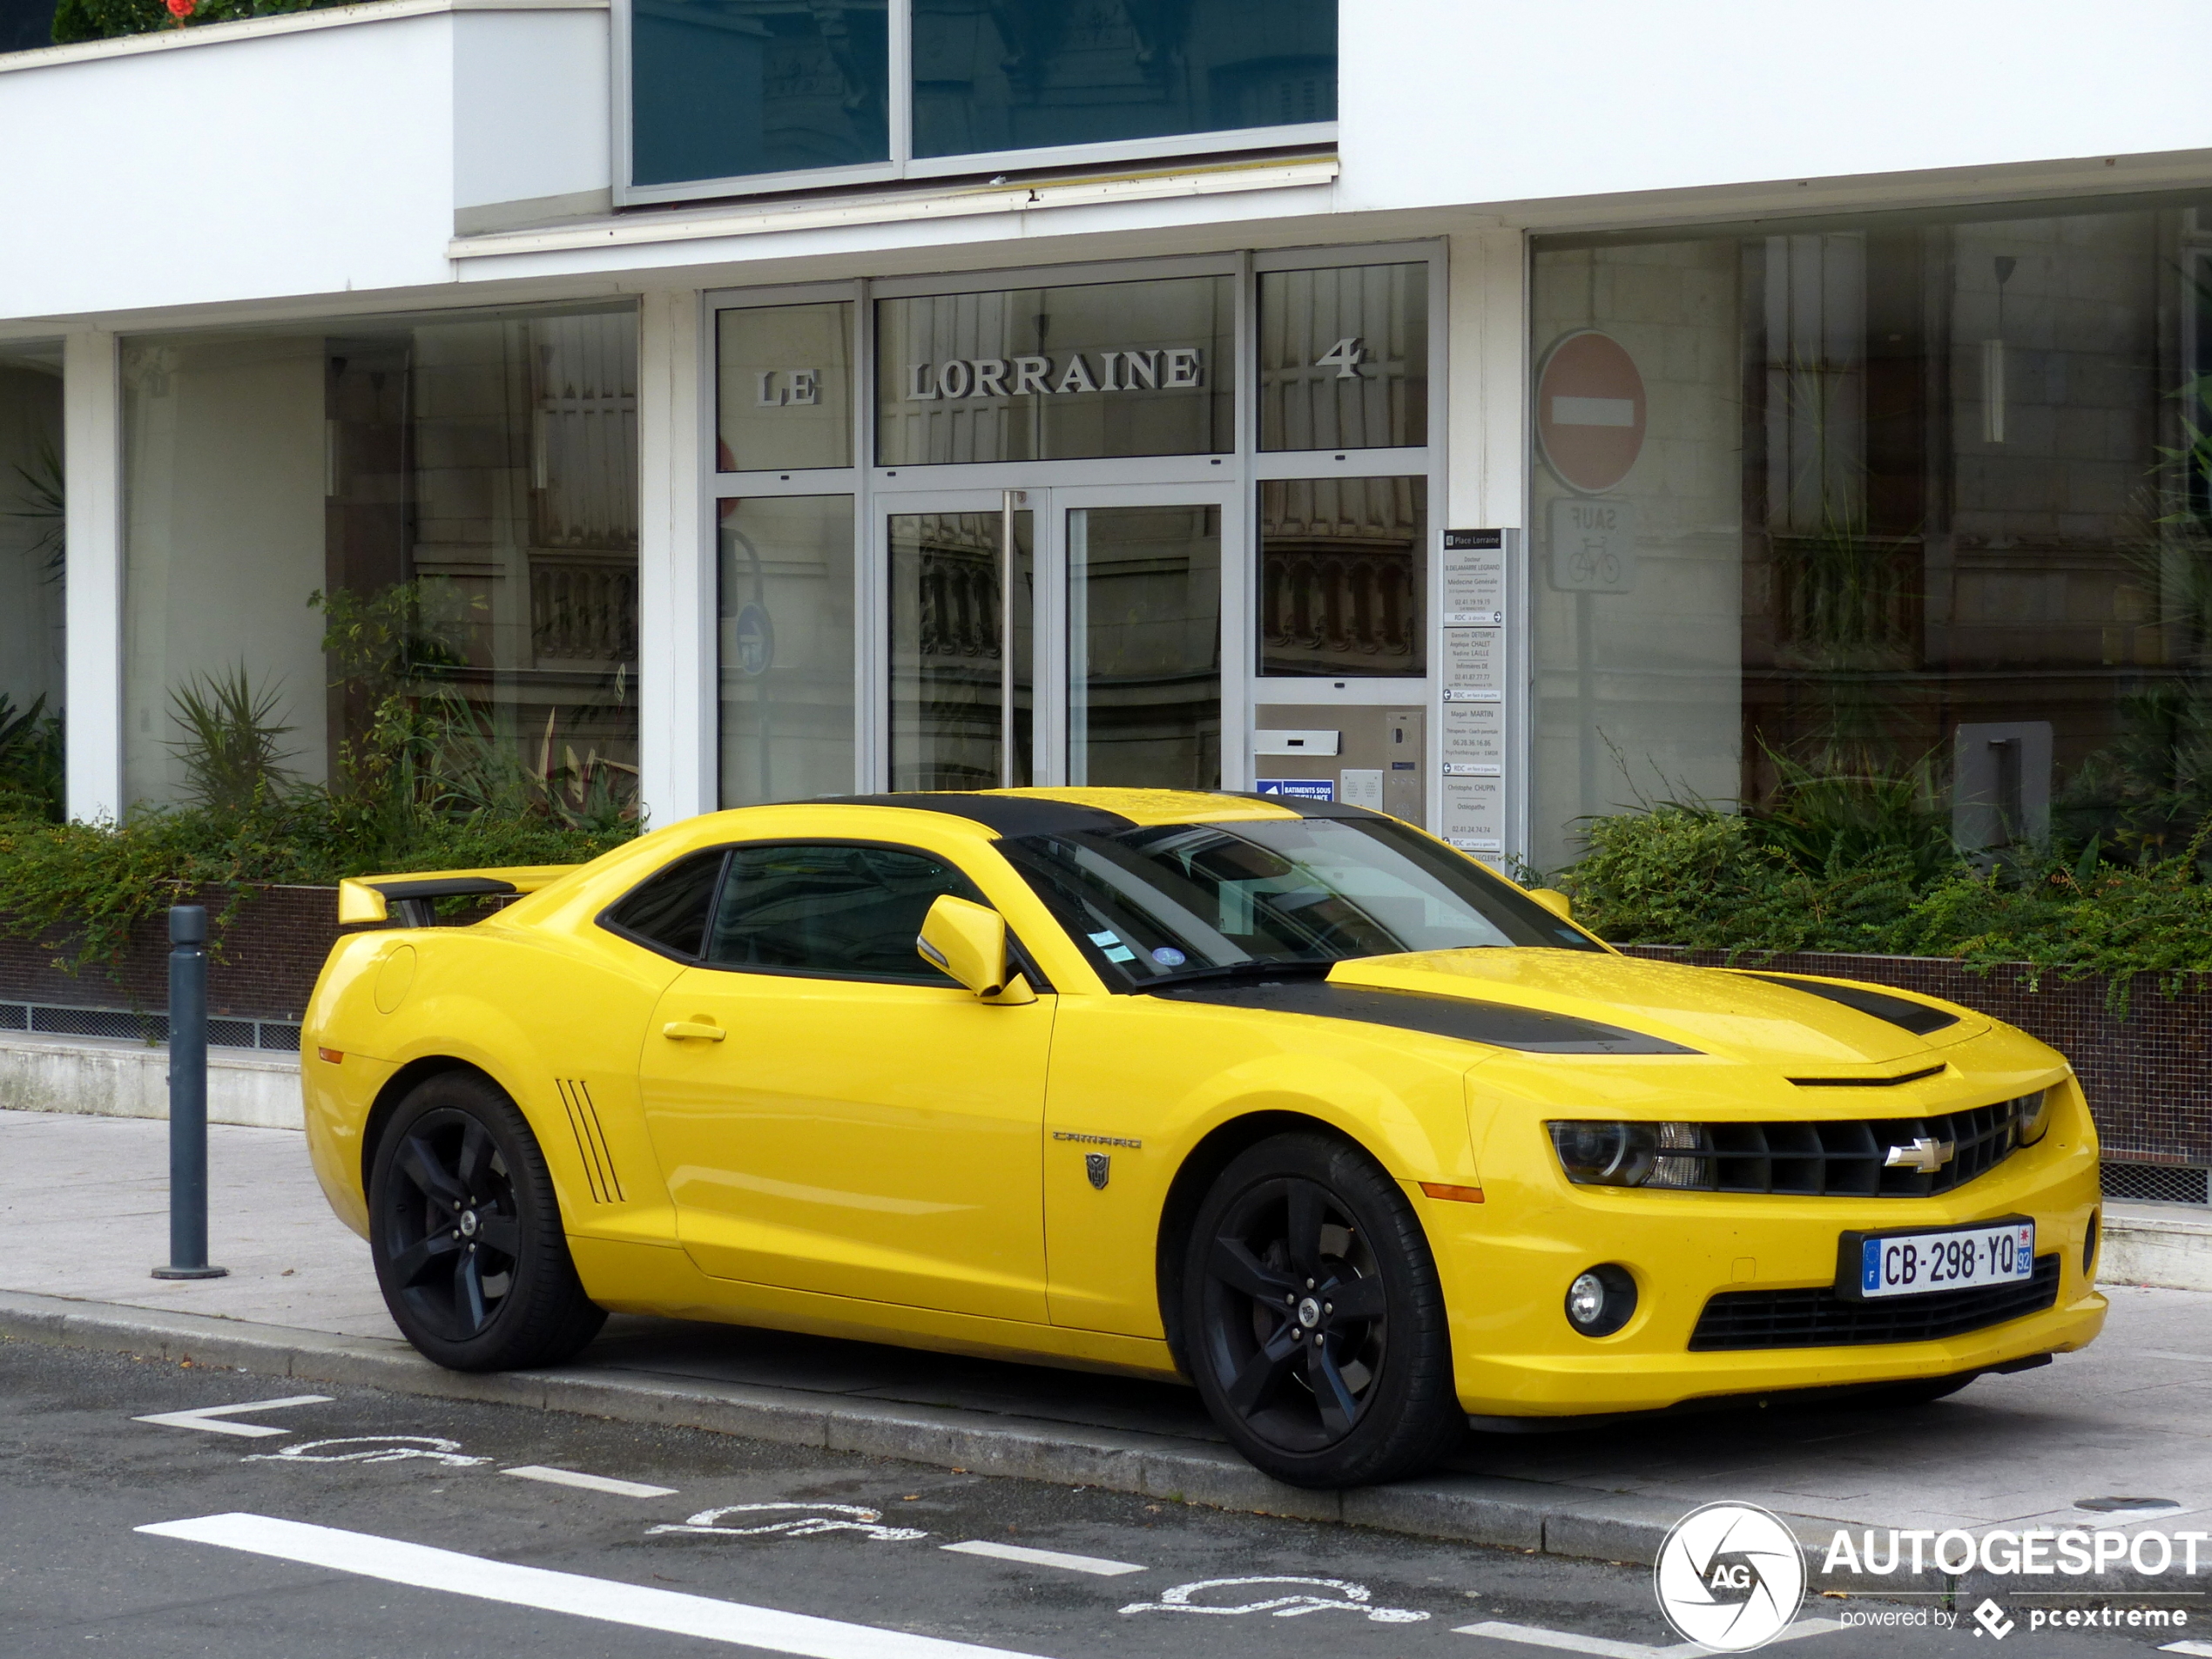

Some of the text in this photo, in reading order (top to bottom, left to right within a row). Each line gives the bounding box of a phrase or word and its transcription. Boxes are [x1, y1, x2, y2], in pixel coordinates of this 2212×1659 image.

[756, 348, 1202, 407] LE LORRAINE
[1316, 337, 1360, 379] 4
[1473, 536, 1499, 544] Lorraine
[1053, 1131, 1142, 1150] CAMARO
[1868, 1234, 2030, 1285] F CB-298-YQ 92
